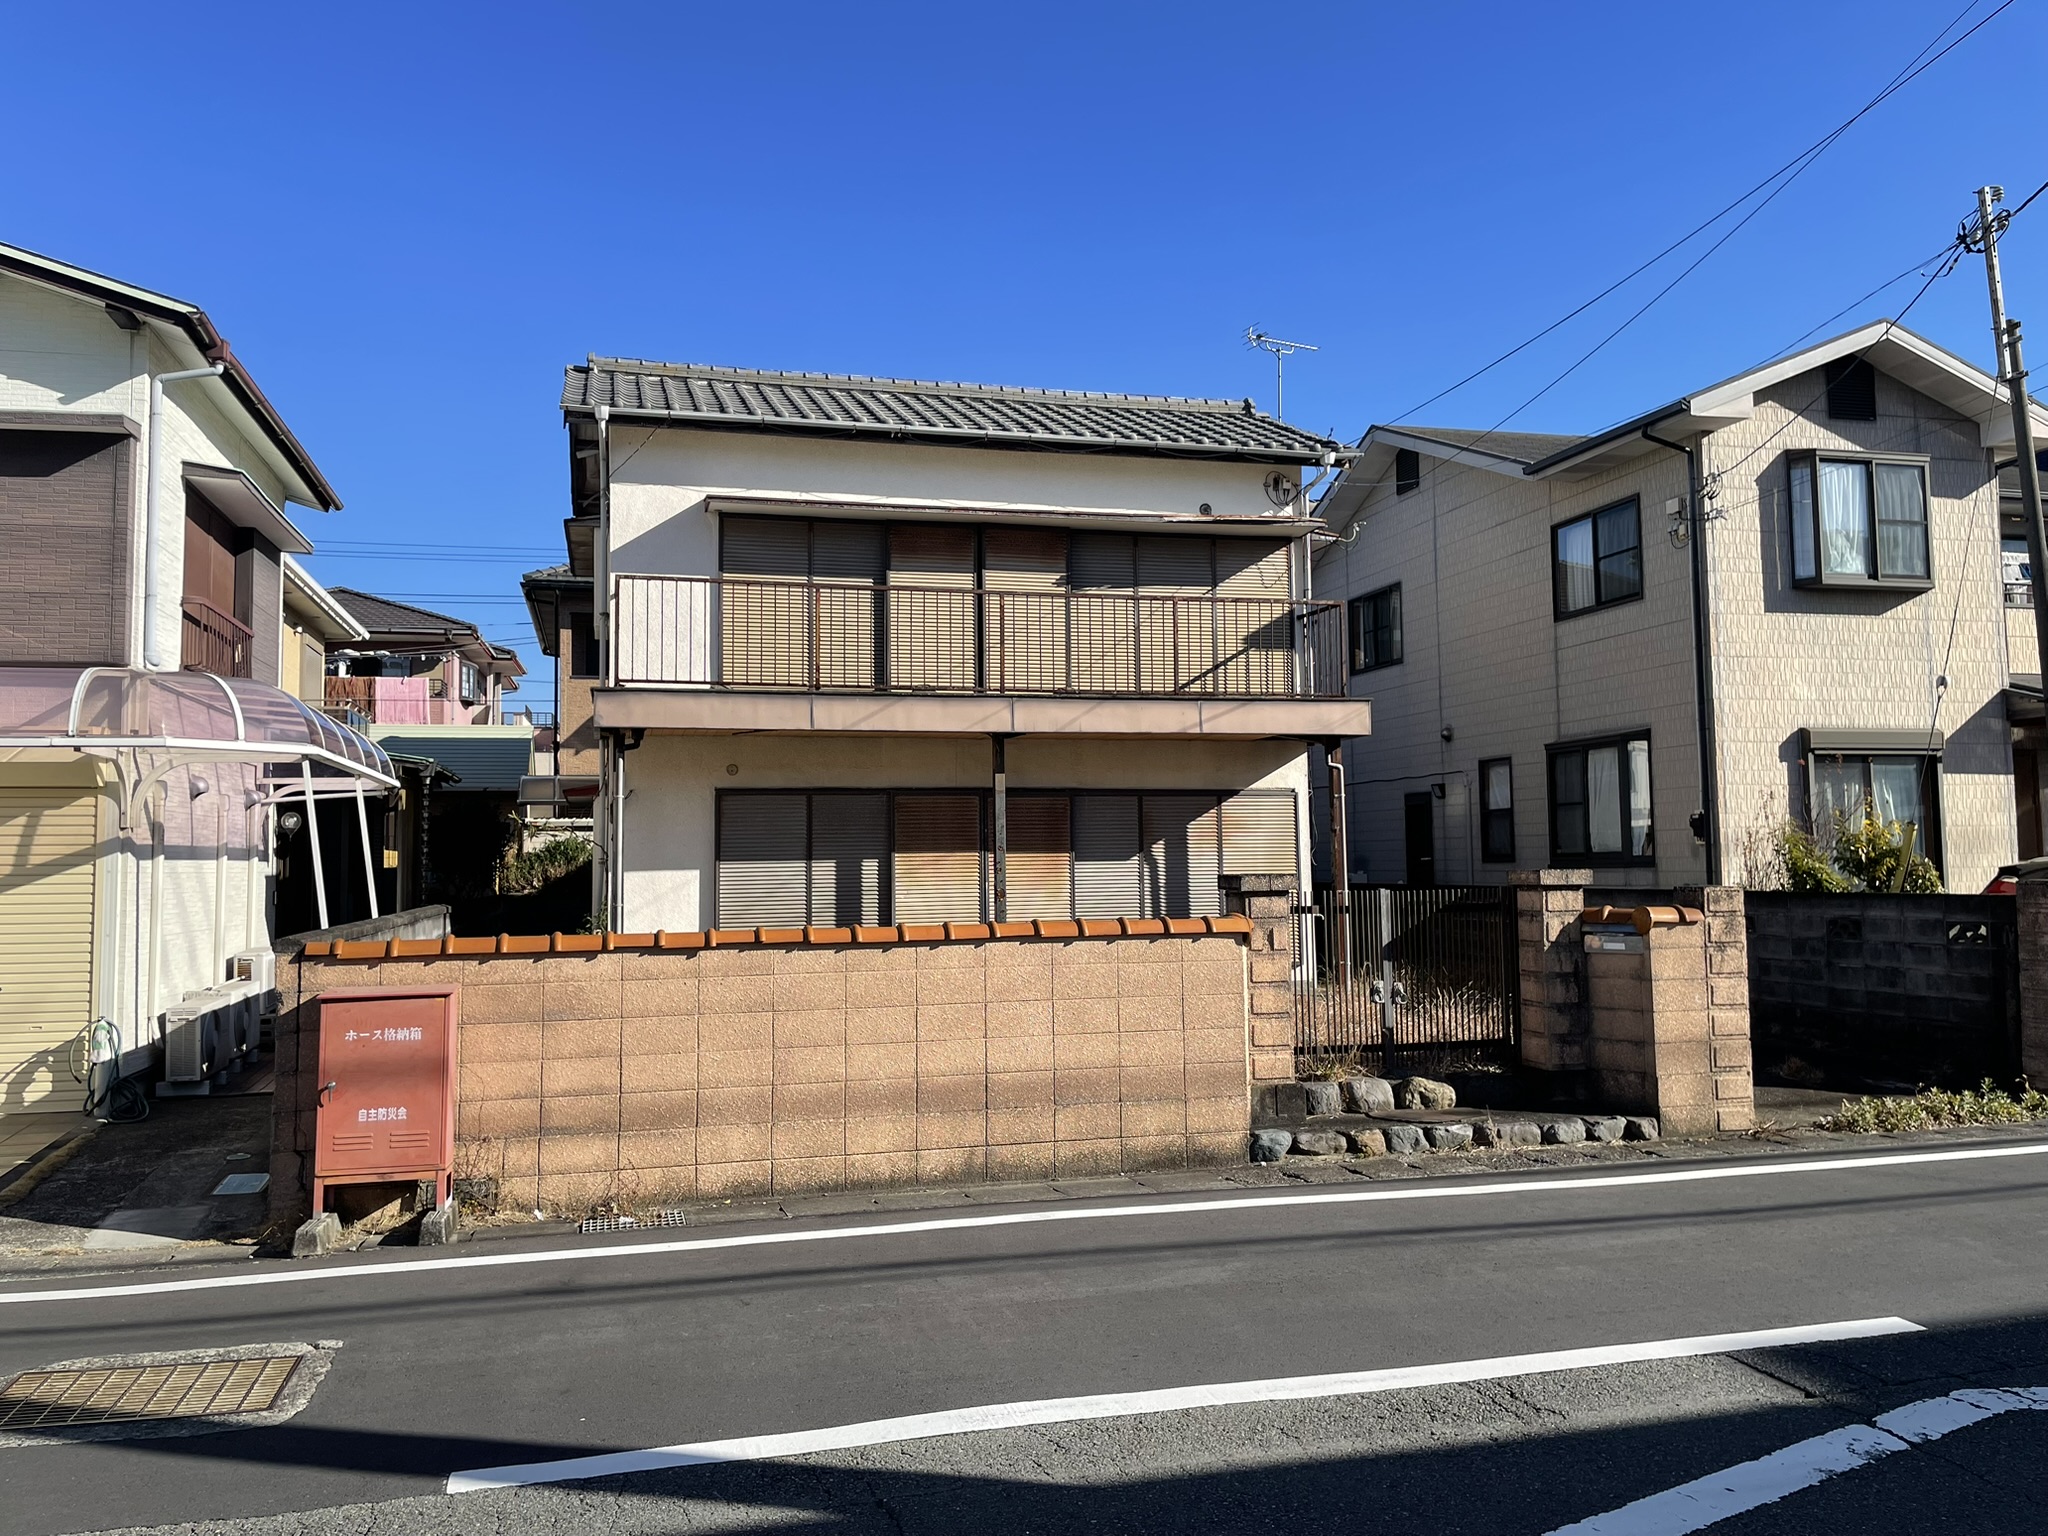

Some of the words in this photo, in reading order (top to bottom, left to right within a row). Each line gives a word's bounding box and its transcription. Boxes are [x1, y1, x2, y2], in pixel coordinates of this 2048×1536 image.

[345, 1026, 423, 1041] ホース格納箱
[358, 1106, 407, 1122] 自主防災会
